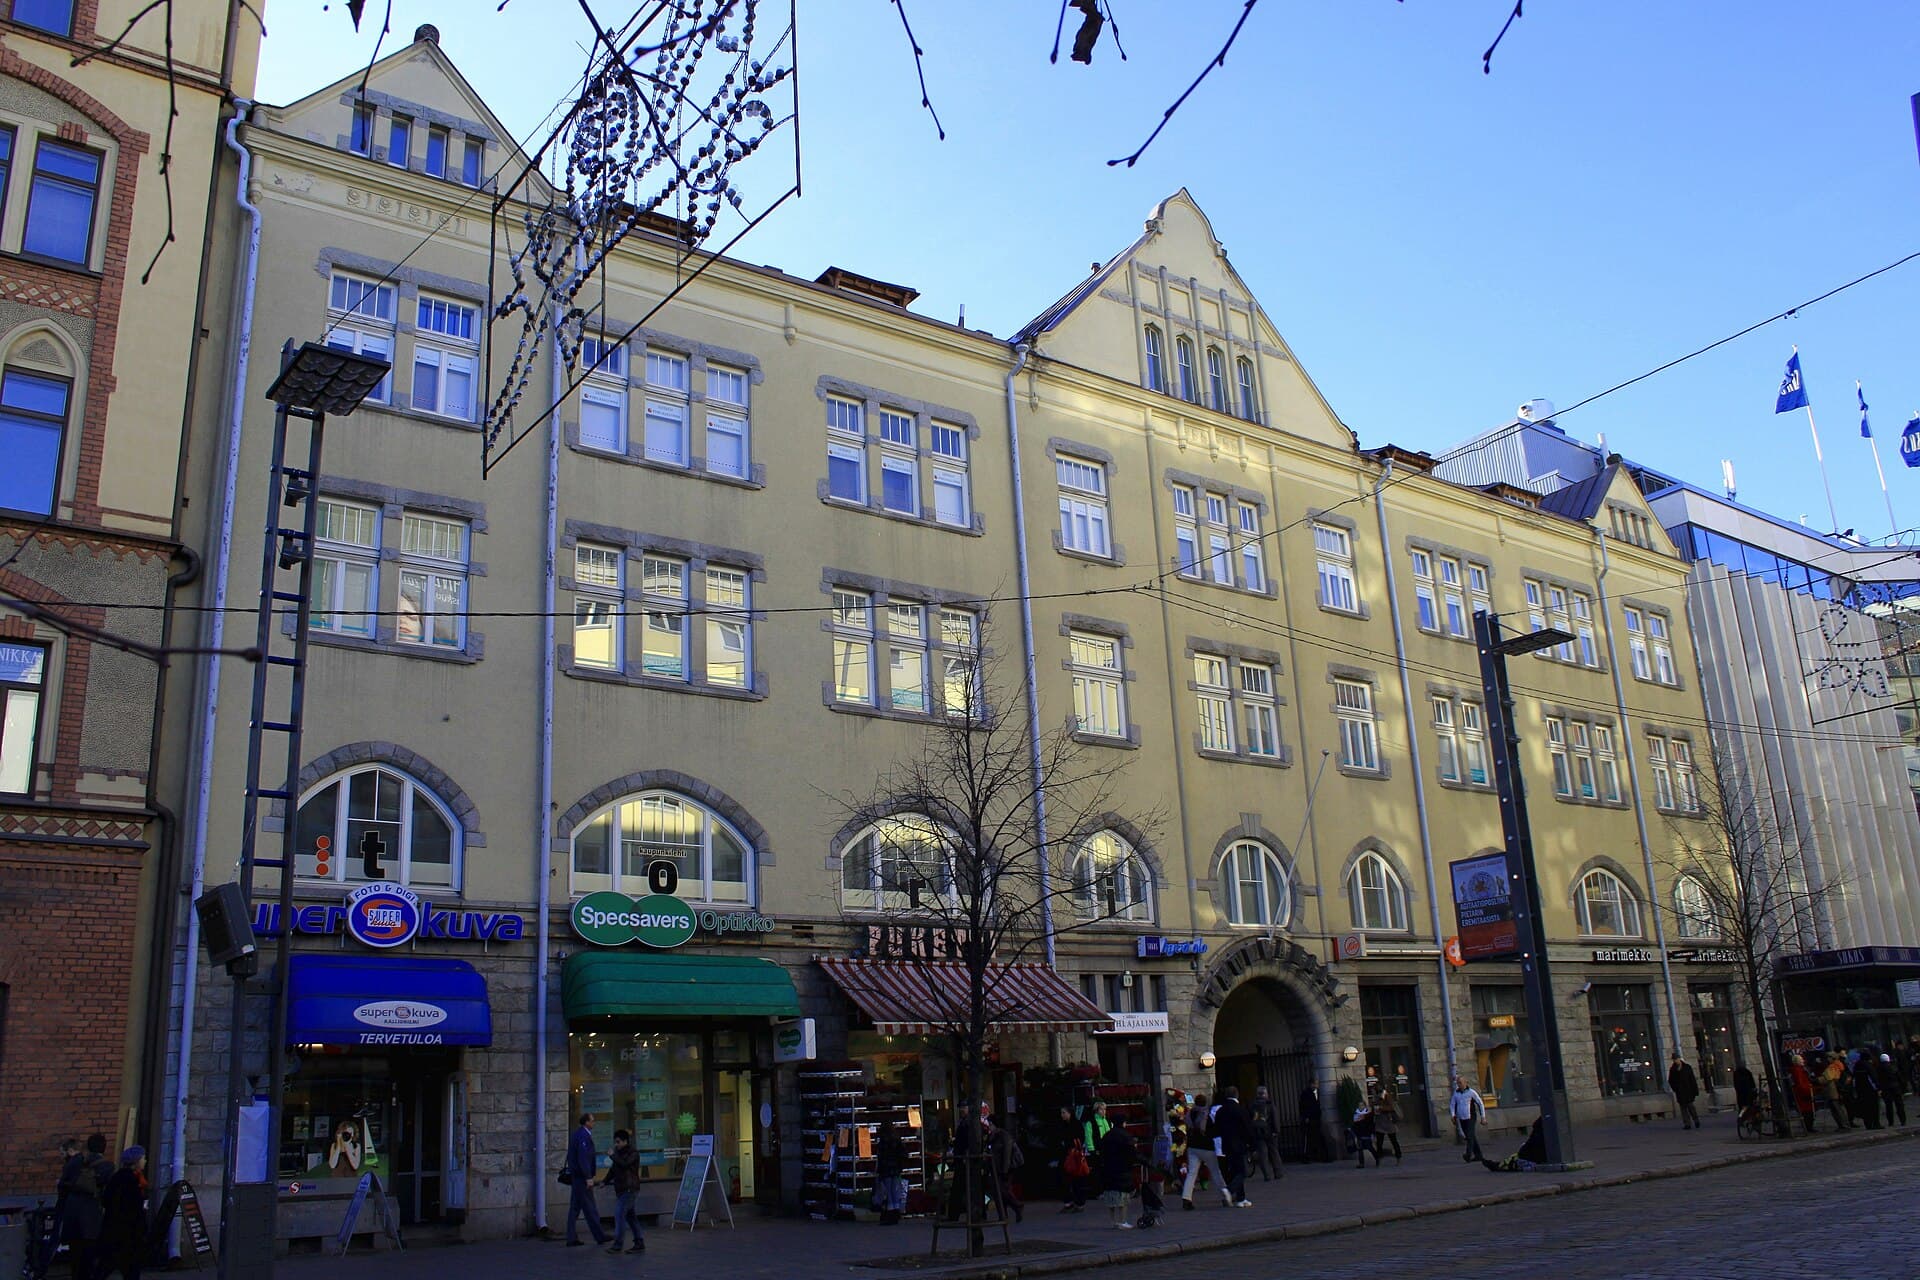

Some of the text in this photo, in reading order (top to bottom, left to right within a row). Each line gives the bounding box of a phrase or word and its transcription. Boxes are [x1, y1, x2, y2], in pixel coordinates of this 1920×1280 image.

[354, 884, 380, 900] FOTO
[396, 886, 416, 902] DIGI
[250, 903, 348, 941] uper
[369, 909, 401, 922] SUPER
[420, 901, 525, 941] kuva
[580, 906, 690, 929] Specsavers
[700, 910, 776, 936] Optikko
[1596, 948, 1652, 961] marimekko
[360, 1007, 440, 1019] super kuva
[1115, 1018, 1165, 1029] HLAJALINNA
[358, 1032, 443, 1046] TERVETULOA
